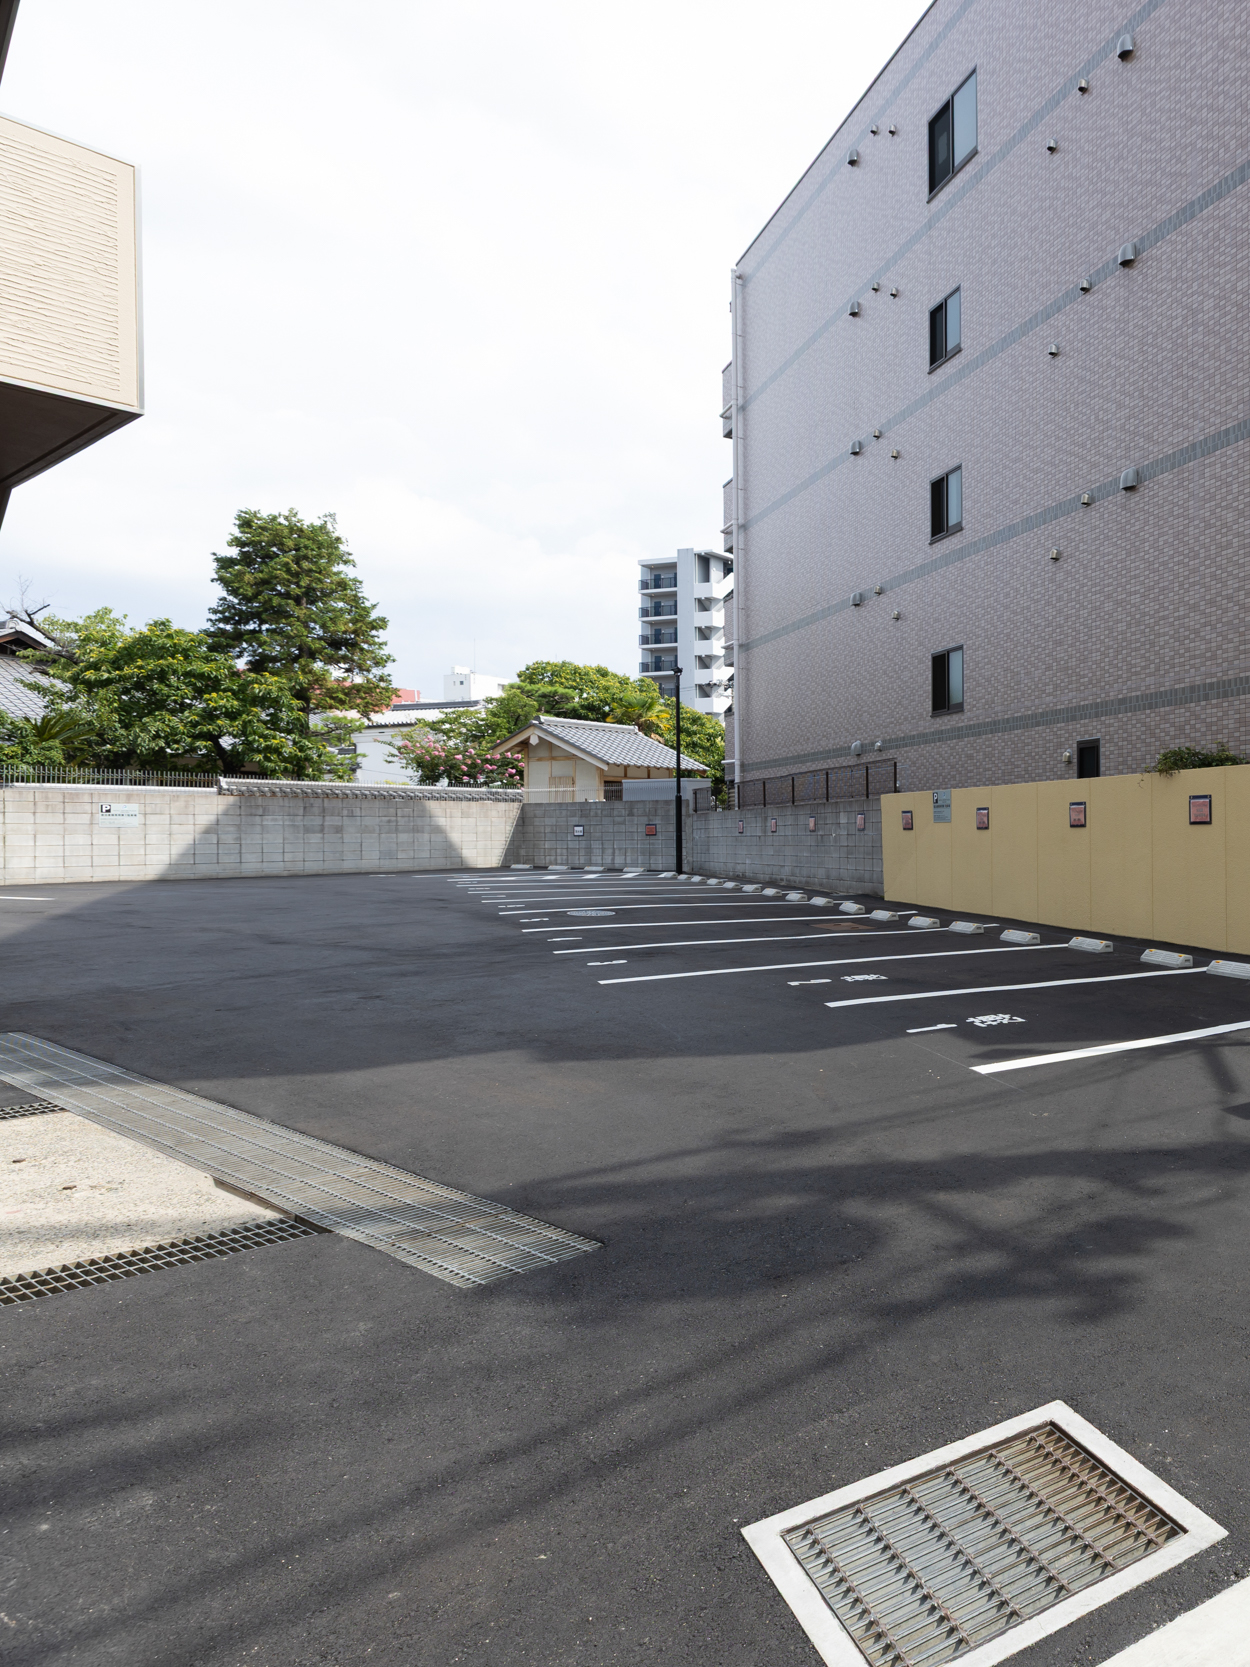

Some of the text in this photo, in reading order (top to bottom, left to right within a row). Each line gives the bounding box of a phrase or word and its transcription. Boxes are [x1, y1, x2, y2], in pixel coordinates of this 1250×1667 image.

[102, 804, 111, 813] P
[787, 978, 832, 986] 2
[906, 1023, 957, 1034] 1
